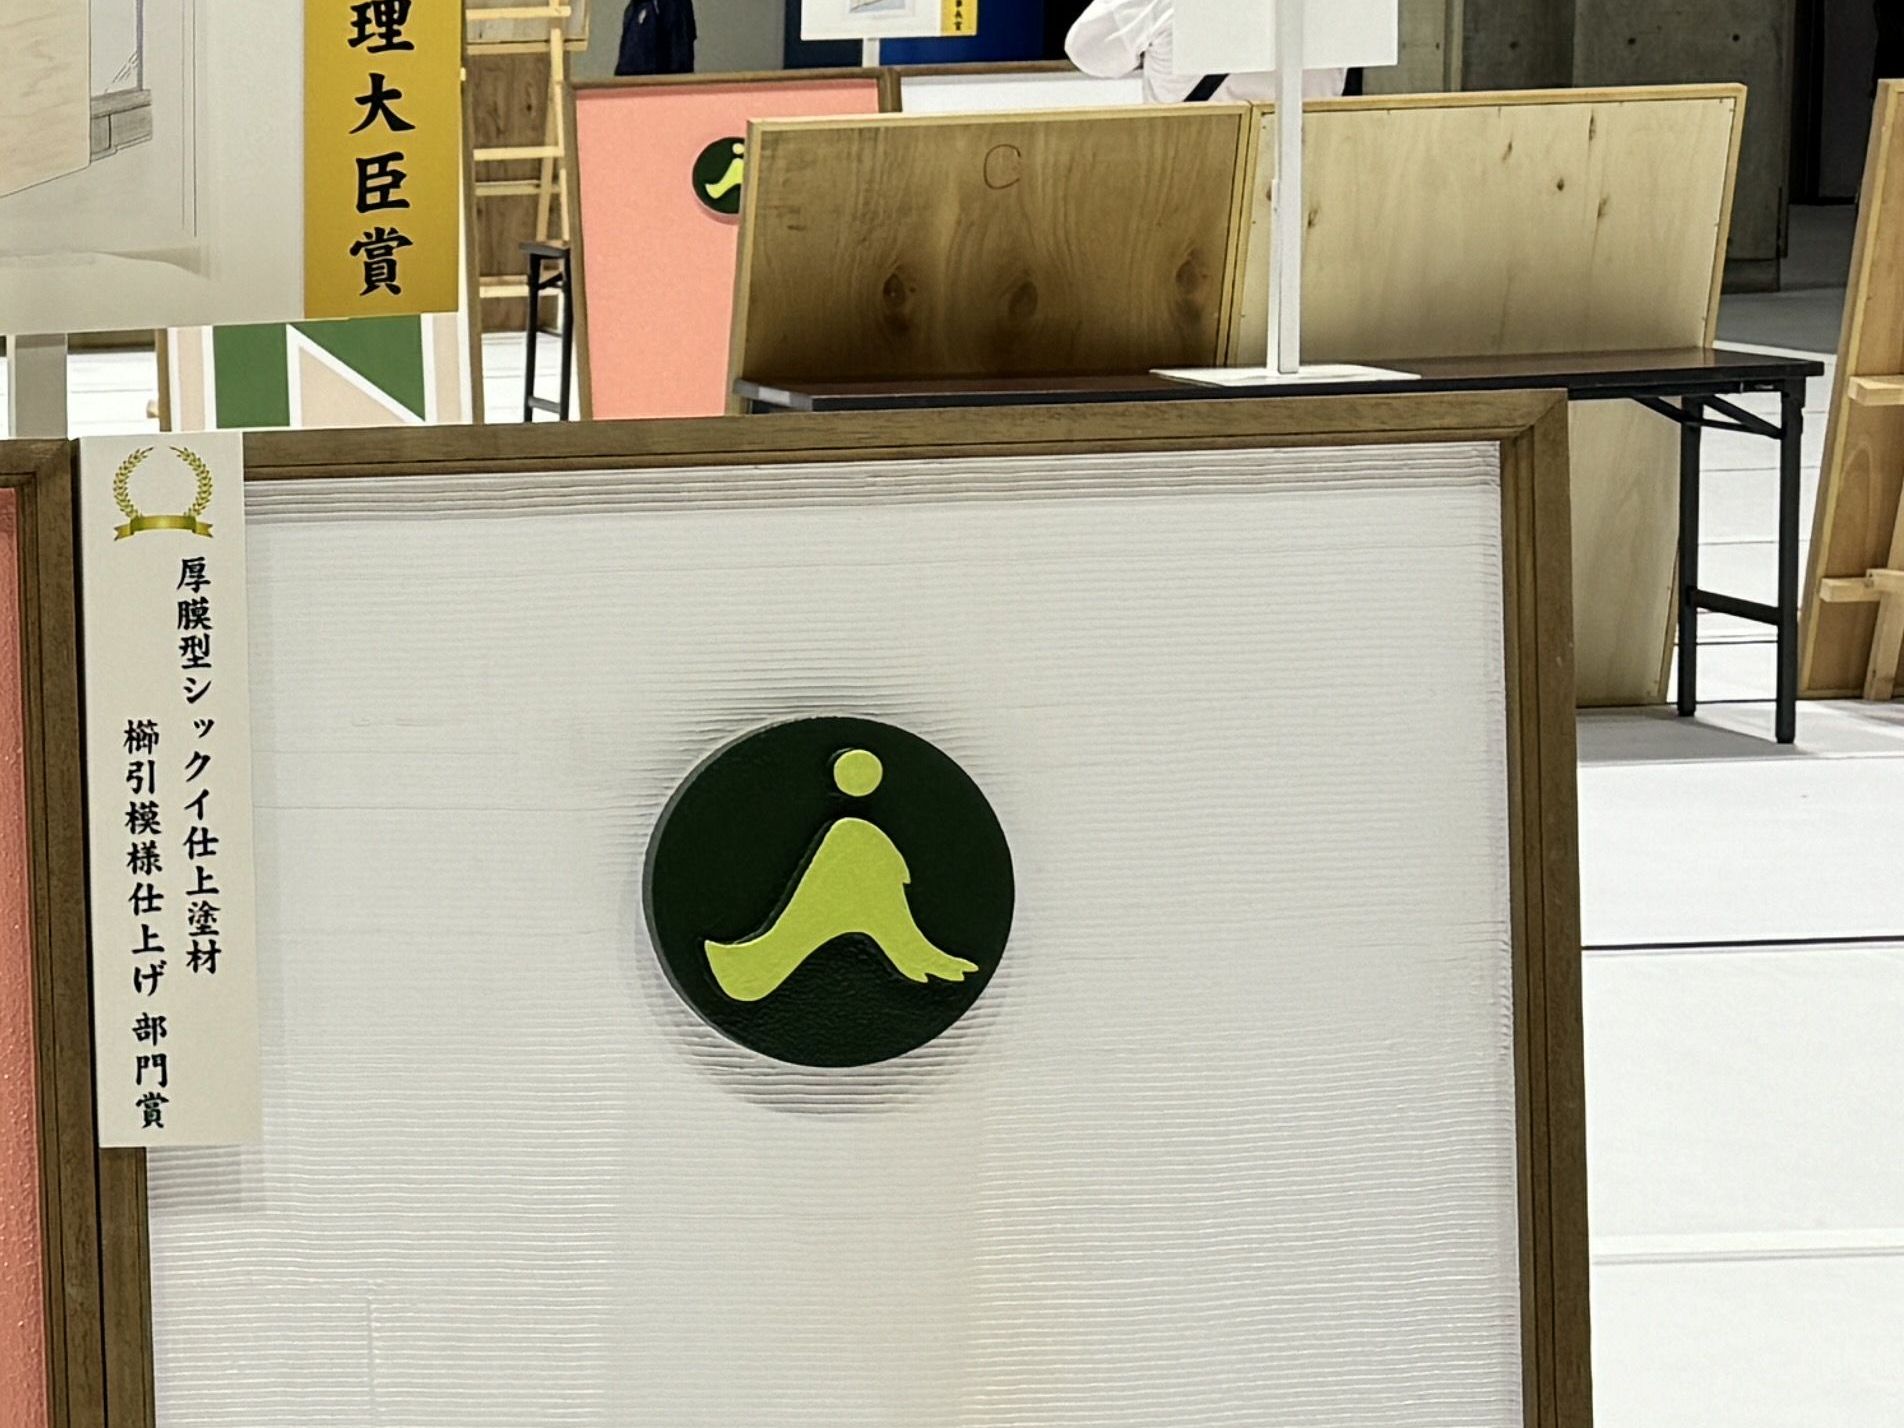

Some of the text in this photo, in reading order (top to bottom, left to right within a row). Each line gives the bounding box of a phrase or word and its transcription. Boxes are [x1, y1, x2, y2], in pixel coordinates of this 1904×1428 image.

[123, 719, 170, 1130] 櫛引模様仕上げ 部門賞
[177, 556, 222, 974] 厚膜型シックイ仕上塗材
